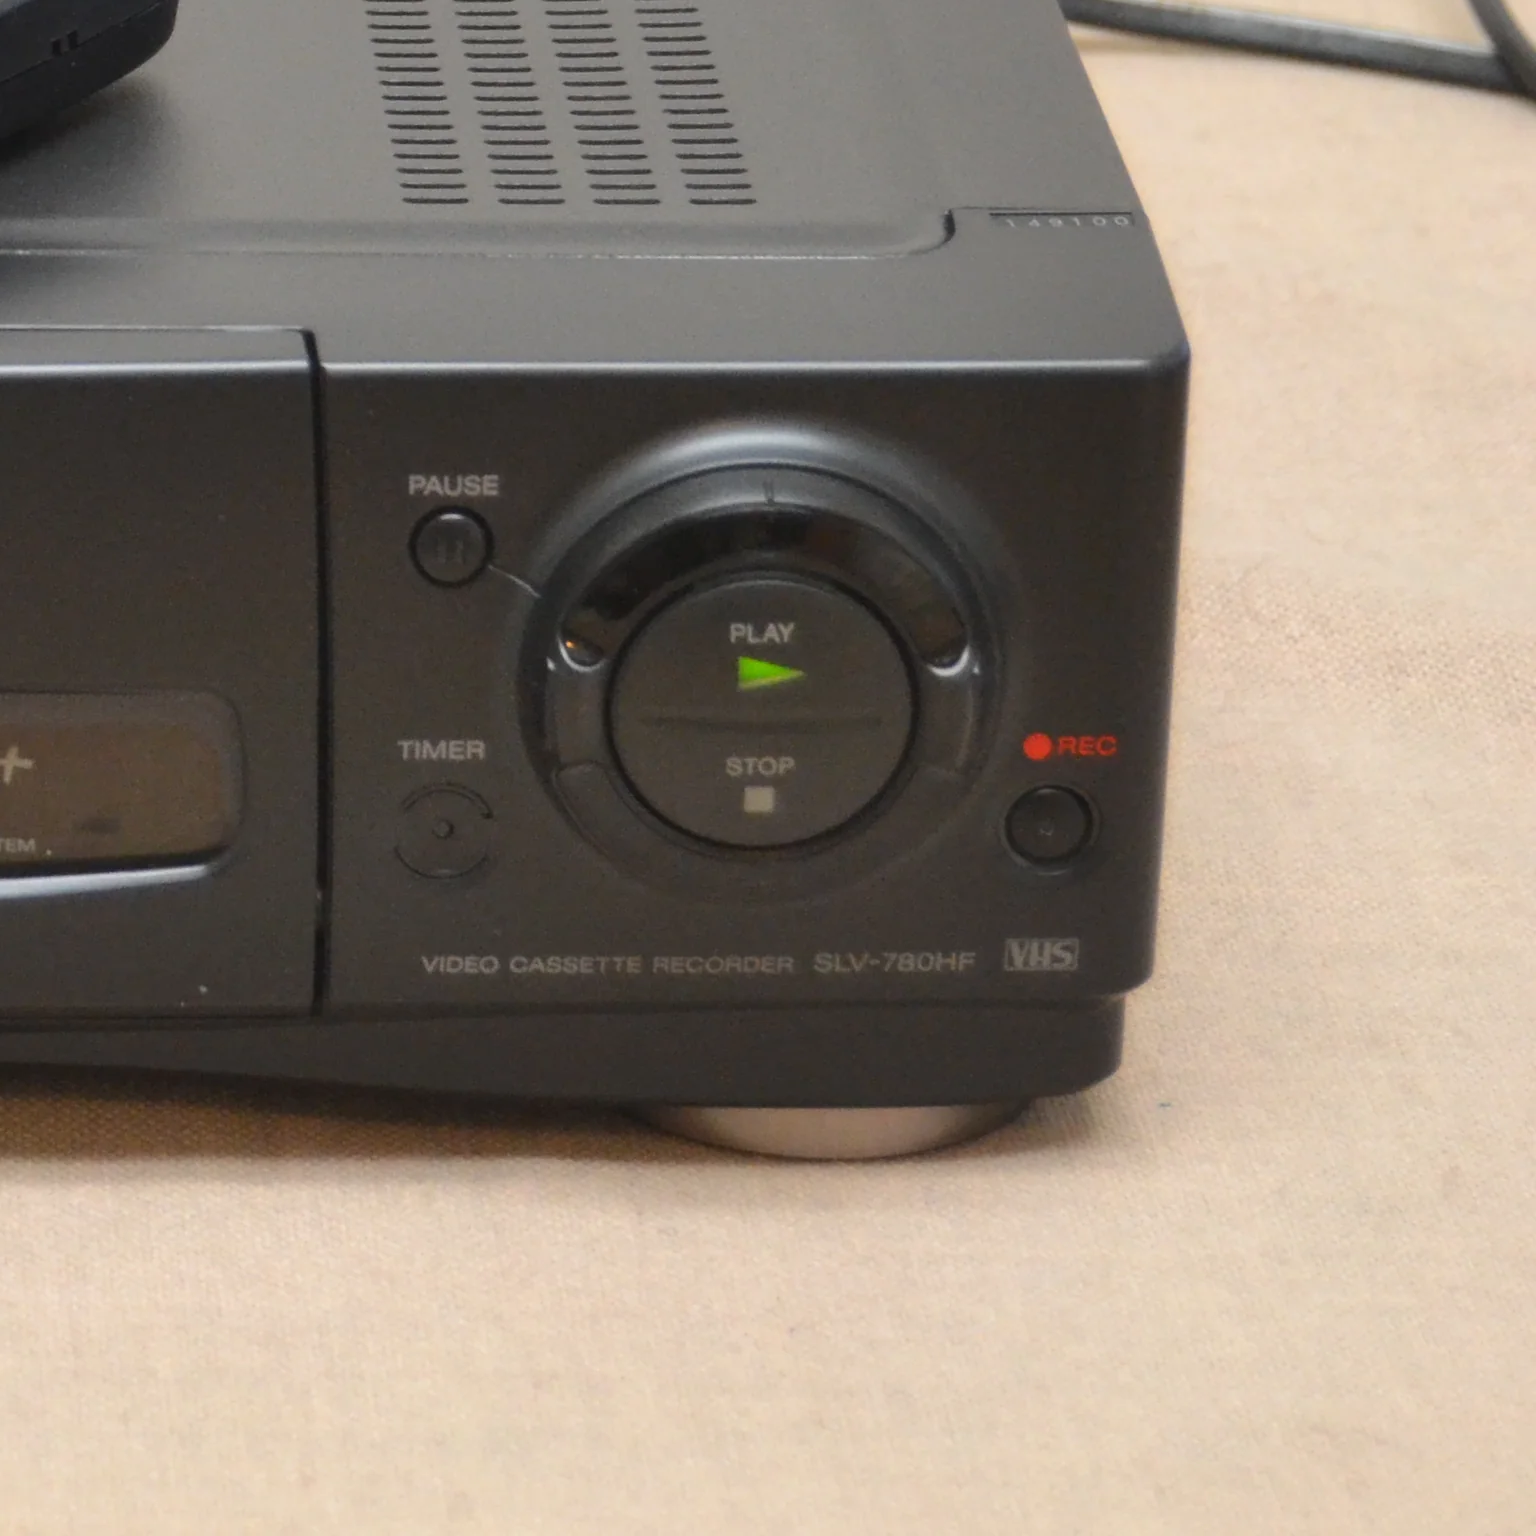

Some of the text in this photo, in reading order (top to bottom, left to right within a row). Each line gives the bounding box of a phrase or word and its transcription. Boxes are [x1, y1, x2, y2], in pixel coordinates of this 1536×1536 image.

[408, 473, 499, 497] PAUSE
[730, 622, 795, 645] PLAY
[396, 739, 486, 761] TIMER
[1057, 735, 1118, 756] REC
[726, 757, 796, 779] STOP
[421, 955, 500, 975] VIDEO
[509, 955, 643, 974] CASSETTE
[651, 953, 796, 975] RECORDER
[1007, 939, 1076, 971] VHS
